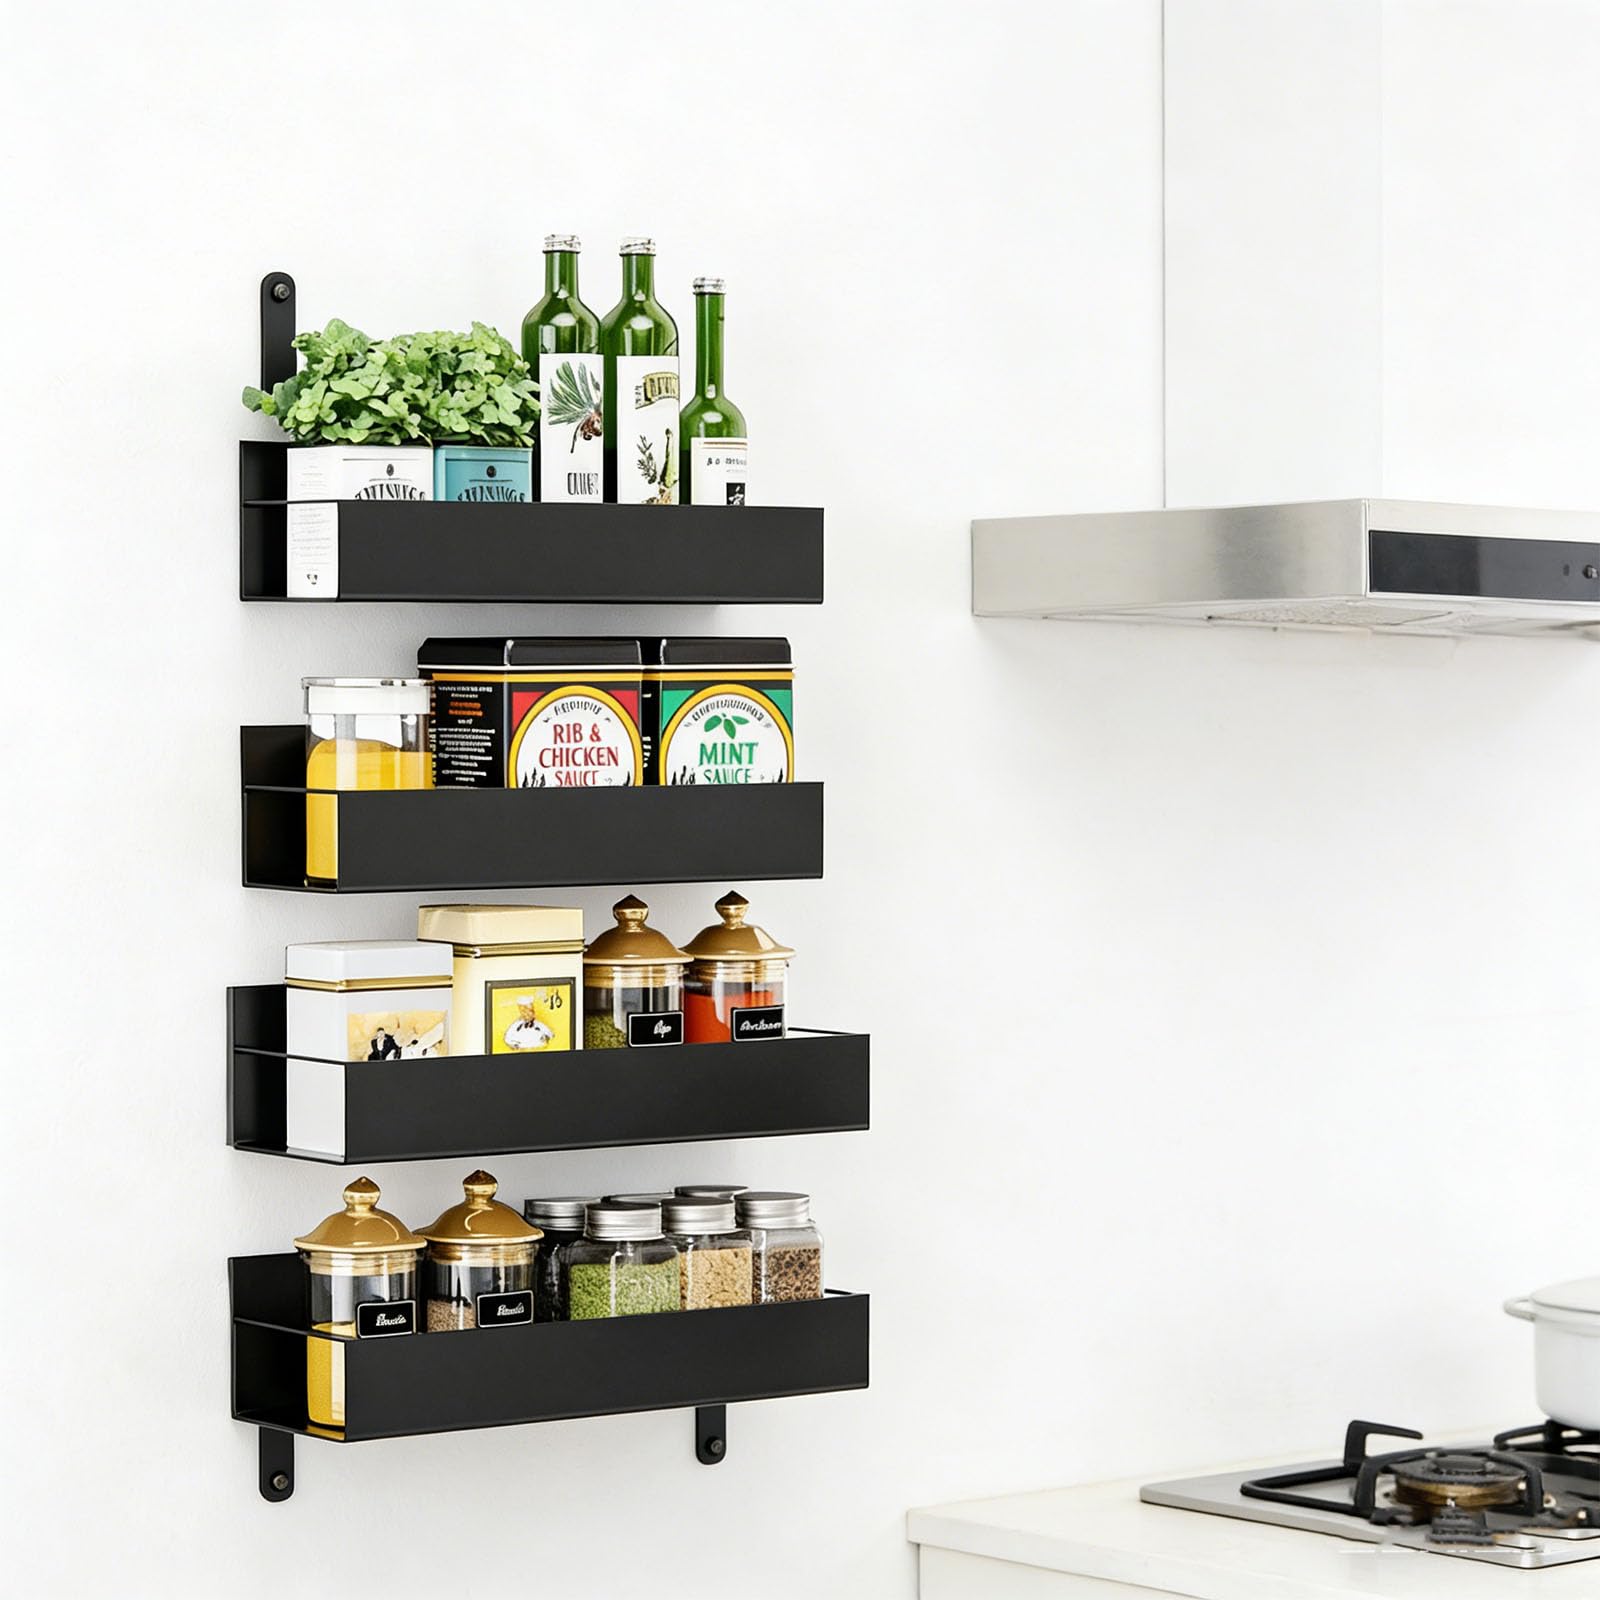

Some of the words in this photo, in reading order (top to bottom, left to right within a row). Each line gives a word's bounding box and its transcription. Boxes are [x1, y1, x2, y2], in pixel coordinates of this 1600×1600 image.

[553, 723, 583, 744] RIB
[589, 723, 602, 743] &
[538, 746, 619, 768] CHICKEN
[698, 742, 759, 767] MINT
